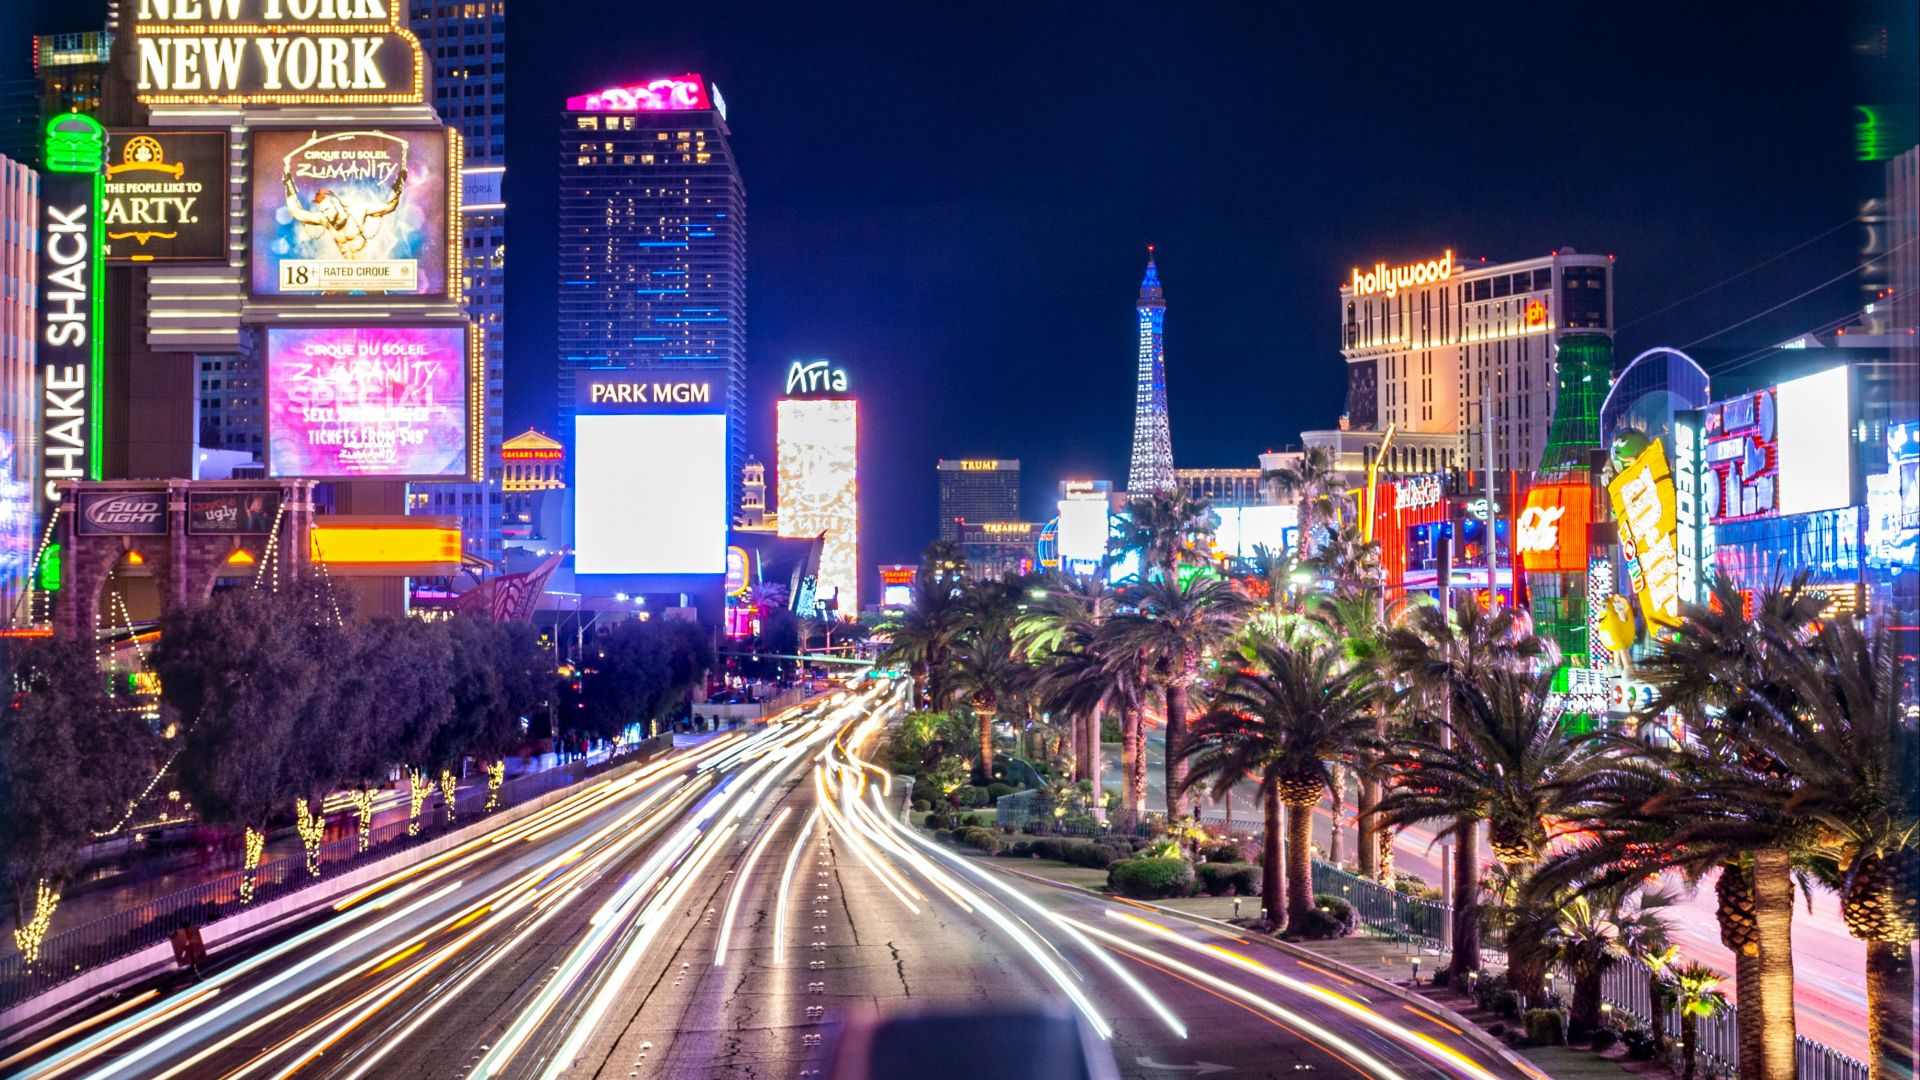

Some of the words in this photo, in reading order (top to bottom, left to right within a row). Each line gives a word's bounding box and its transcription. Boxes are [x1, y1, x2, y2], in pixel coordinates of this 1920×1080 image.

[137, 37, 247, 90] NEW
[256, 37, 386, 90] YORK
[304, 151, 340, 161] CIRQUE
[342, 151, 356, 159] DU
[357, 151, 390, 159] SOLEIL
[105, 183, 125, 193] THE
[127, 183, 162, 193] PEOPLE
[163, 183, 186, 193] LIKE
[187, 183, 202, 193] TO
[47, 204, 87, 347] SHACK
[324, 267, 353, 276] RATED
[356, 267, 390, 277] CIRQUE
[1353, 250, 1451, 298] hollywood
[305, 344, 355, 358] CIRQUE
[359, 344, 378, 356] DU
[382, 344, 427, 356] SOLEIL
[786, 361, 848, 394] Aria
[592, 383, 648, 403] PARK
[653, 383, 710, 403] MGM
[308, 430, 357, 445] TICKETS
[961, 461, 998, 470] TRUMP
[106, 501, 159, 513] BUD
[205, 505, 238, 521] ugly
[1675, 422, 1696, 603] SKECHERS
[94, 513, 162, 523] LIGHT
[983, 524, 1031, 532] TREASURE
